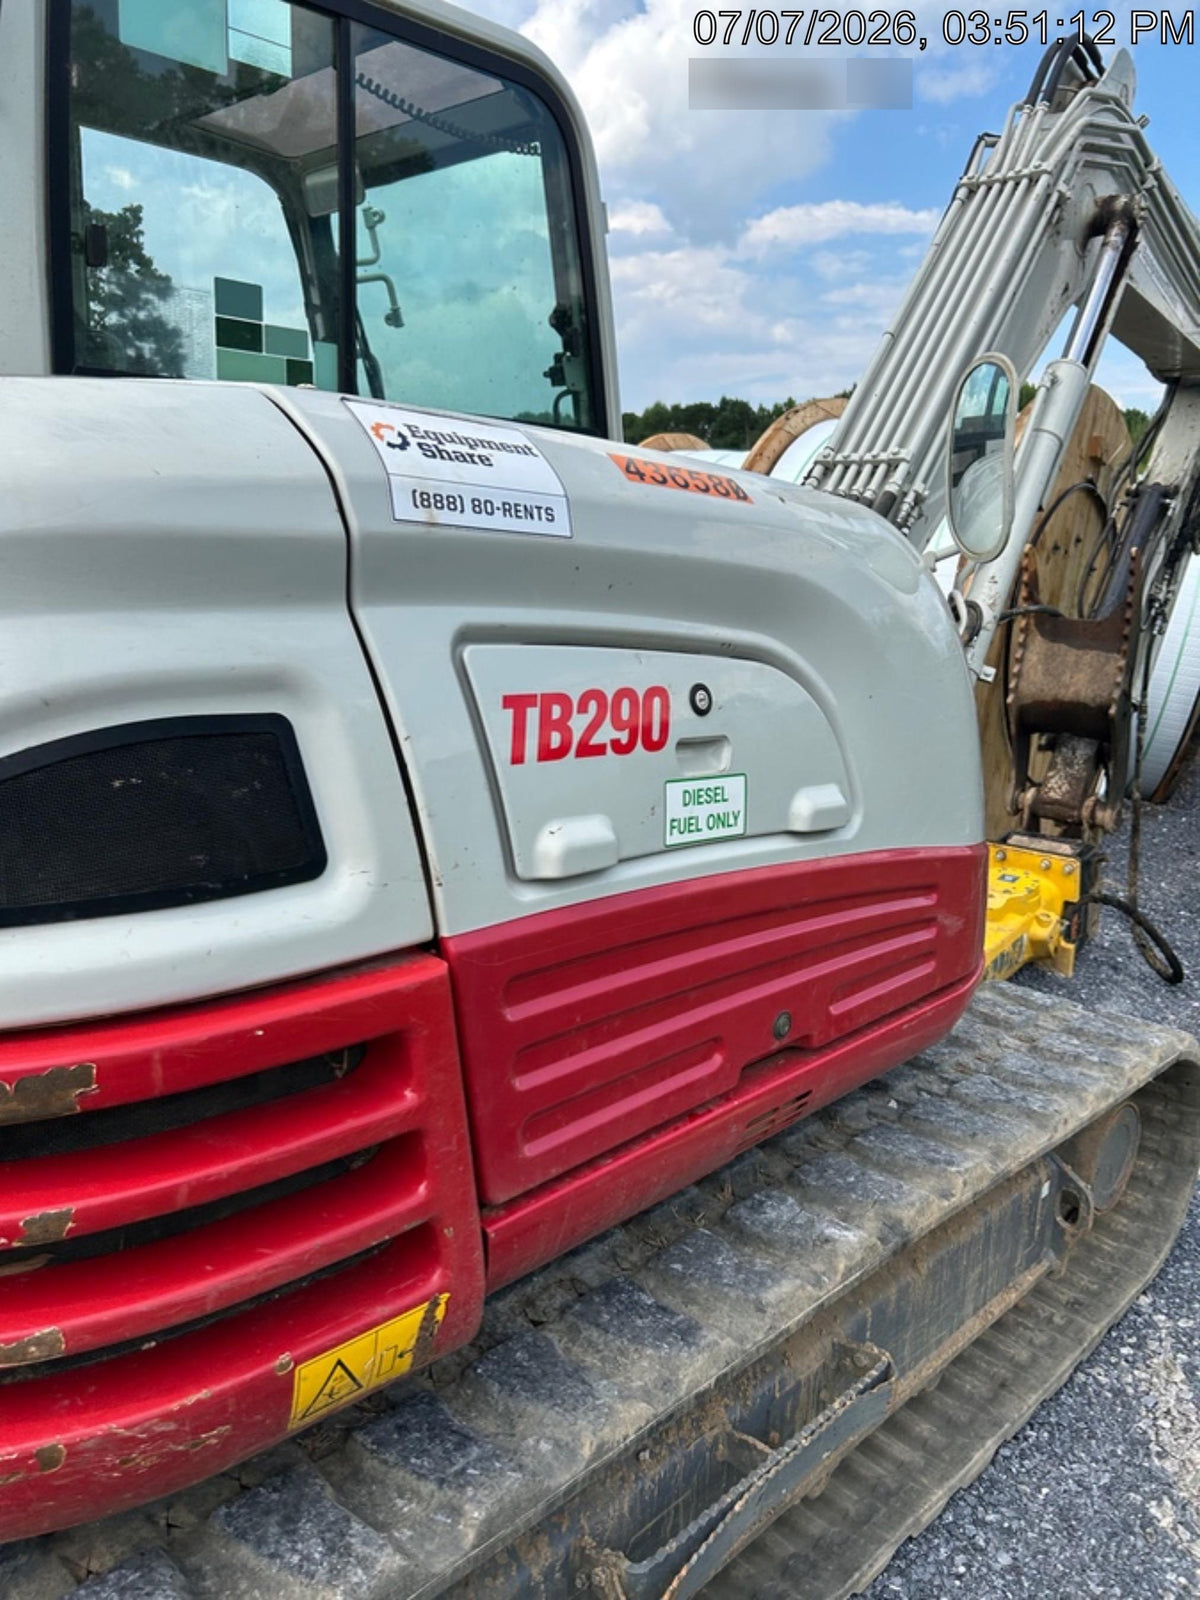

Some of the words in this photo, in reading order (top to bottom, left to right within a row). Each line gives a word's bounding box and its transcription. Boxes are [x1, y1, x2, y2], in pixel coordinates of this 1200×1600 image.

[406, 424, 539, 458] Equipment
[420, 441, 494, 467] Share
[411, 488, 465, 516] (888)
[471, 497, 556, 522] 80-RENTS
[502, 685, 671, 765] TB290
[682, 786, 729, 807] DIESEL
[669, 818, 703, 837] FUEL
[706, 810, 741, 831] ONLY
